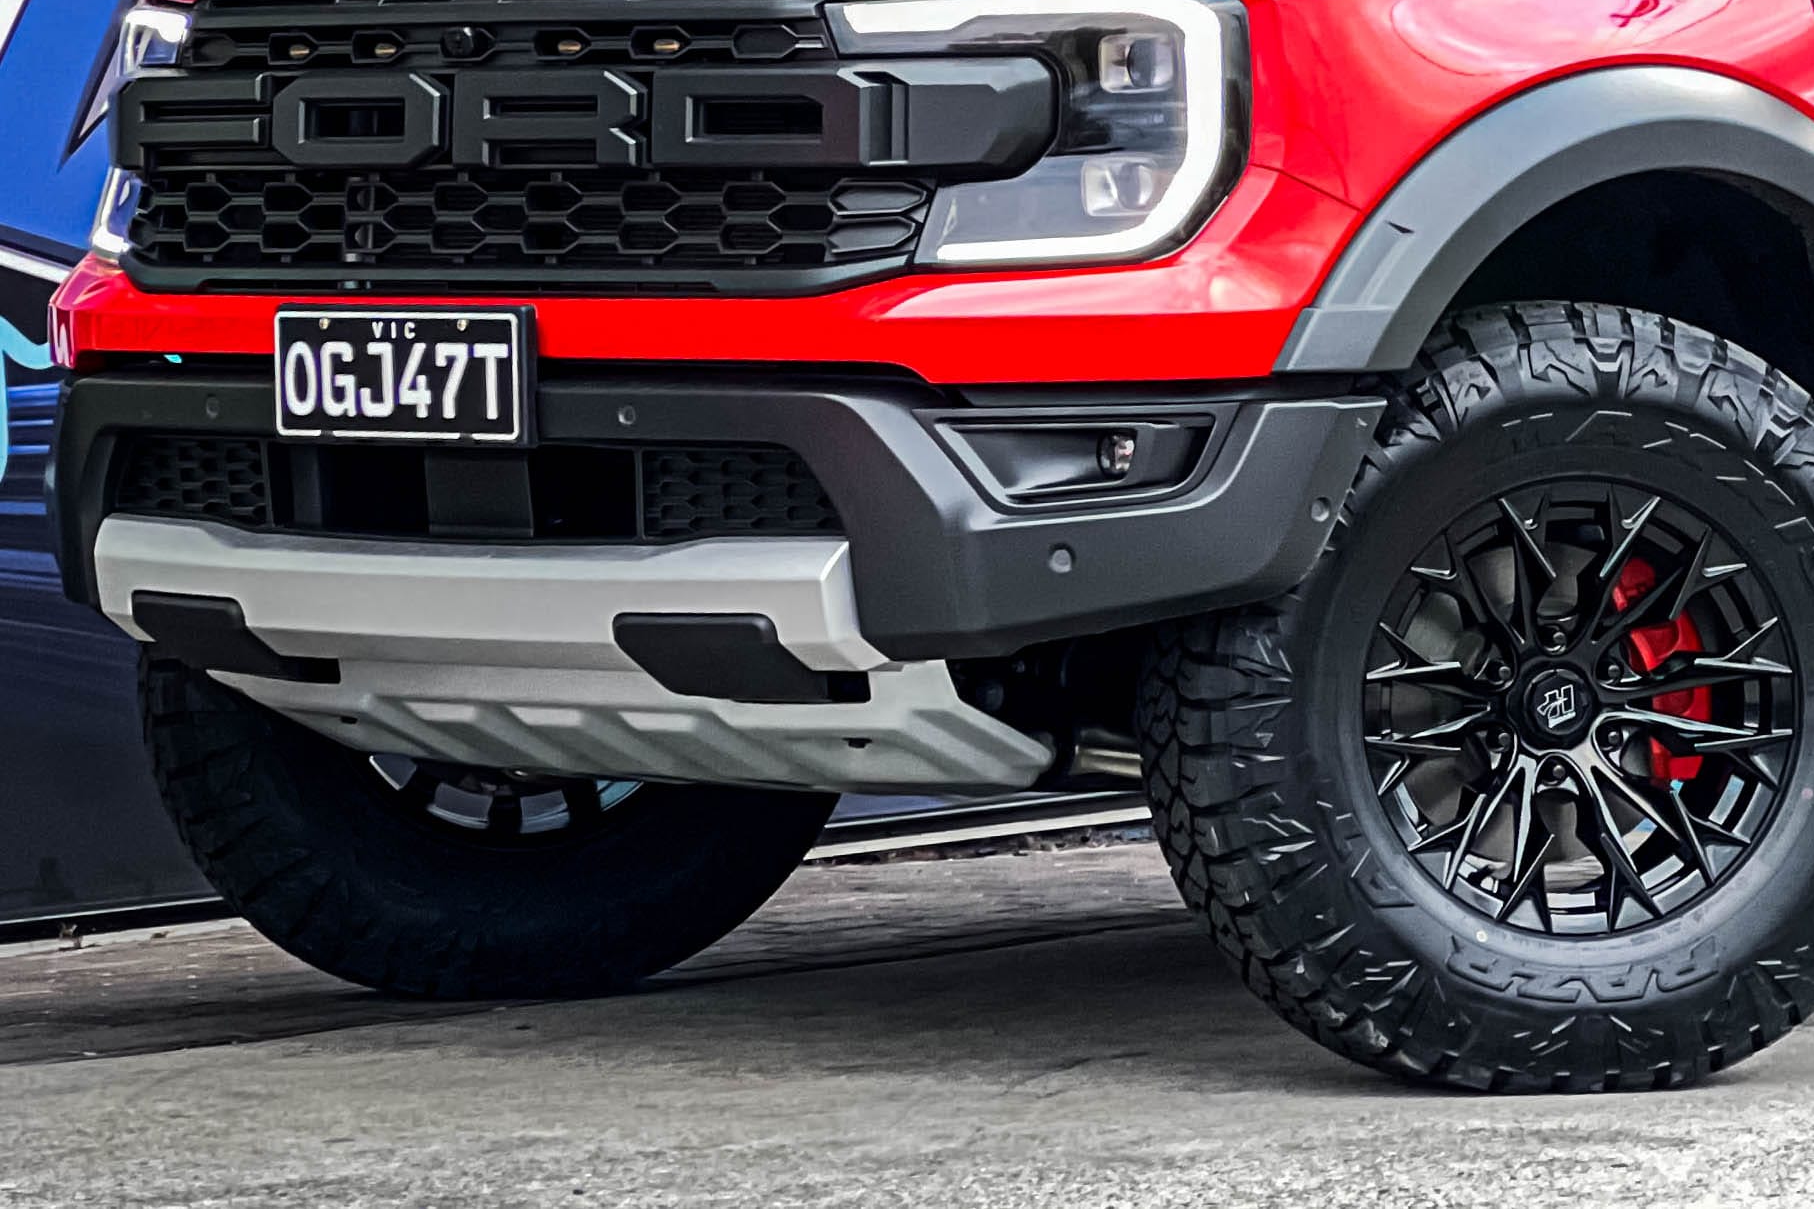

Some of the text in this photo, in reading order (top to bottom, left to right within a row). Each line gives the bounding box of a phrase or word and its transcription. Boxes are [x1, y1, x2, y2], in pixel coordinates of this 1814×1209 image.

[110, 68, 880, 170] FORD
[371, 321, 417, 339] VIC
[1446, 935, 1718, 1004] RAZR
